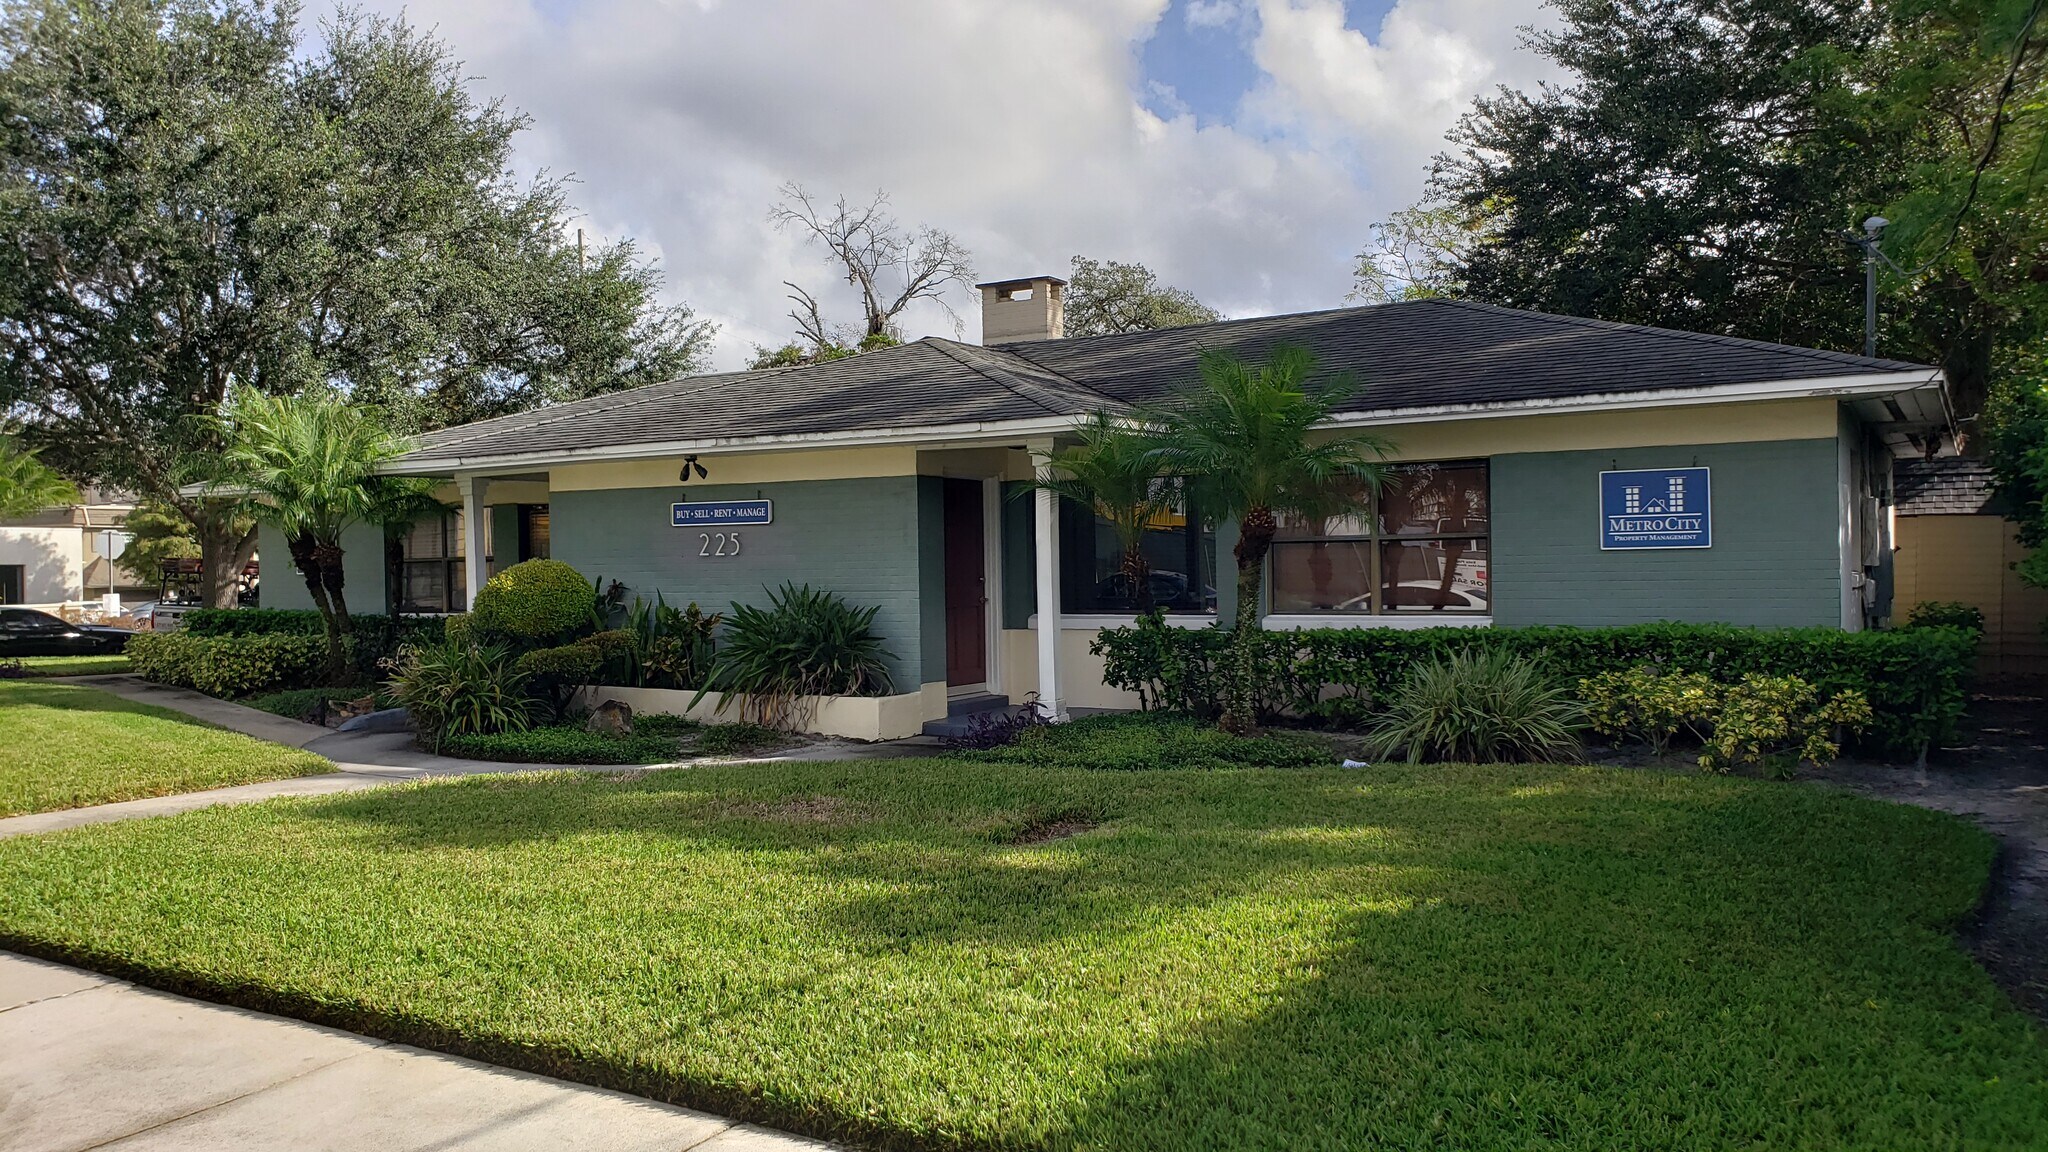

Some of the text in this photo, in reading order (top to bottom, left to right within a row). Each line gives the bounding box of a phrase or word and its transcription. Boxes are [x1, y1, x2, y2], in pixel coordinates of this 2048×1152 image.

[676, 507, 766, 519] BUY SELL RENT MANAGE
[699, 532, 740, 556] 225
